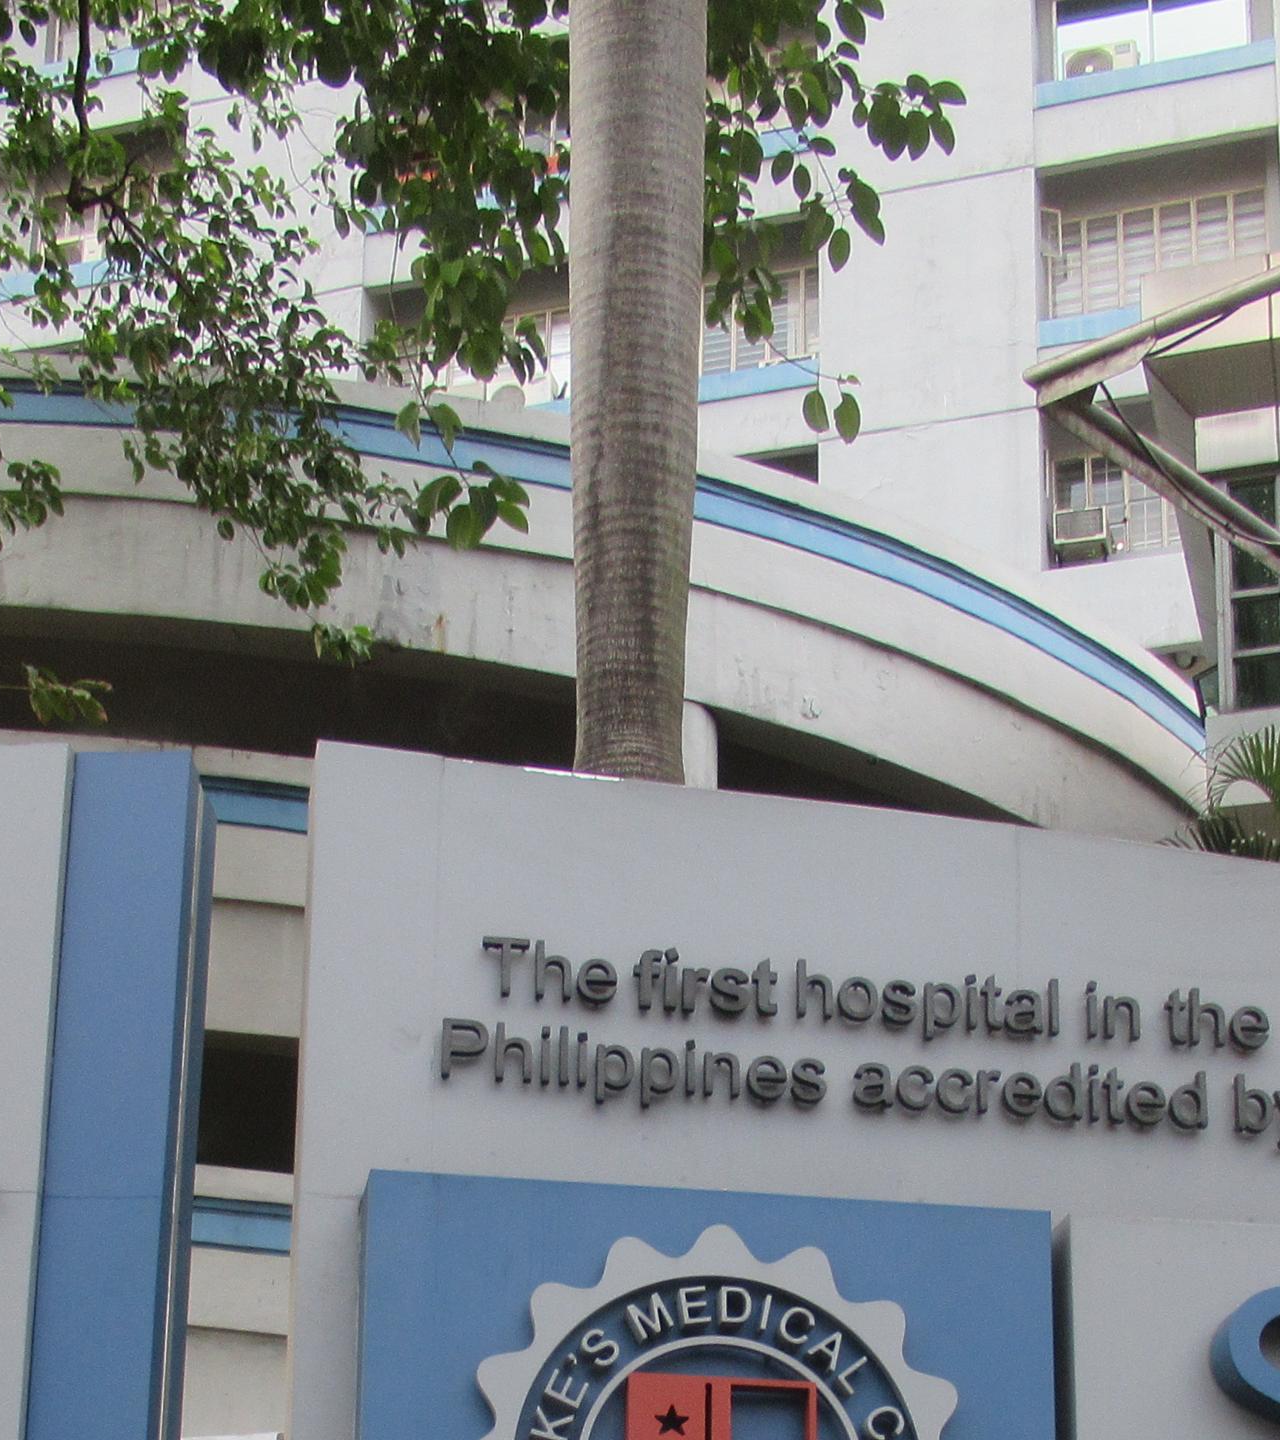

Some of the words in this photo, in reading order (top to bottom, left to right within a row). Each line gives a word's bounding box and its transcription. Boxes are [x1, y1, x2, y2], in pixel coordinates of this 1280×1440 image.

[482, 936, 618, 1004] The
[633, 948, 779, 1017] first
[795, 959, 1061, 1042] hospital
[1085, 980, 1141, 1043] in
[1163, 987, 1270, 1051] the
[439, 1017, 828, 1109] Philippines
[851, 1063, 1210, 1132] accredited
[625, 1284, 872, 1397] MEDICAL
